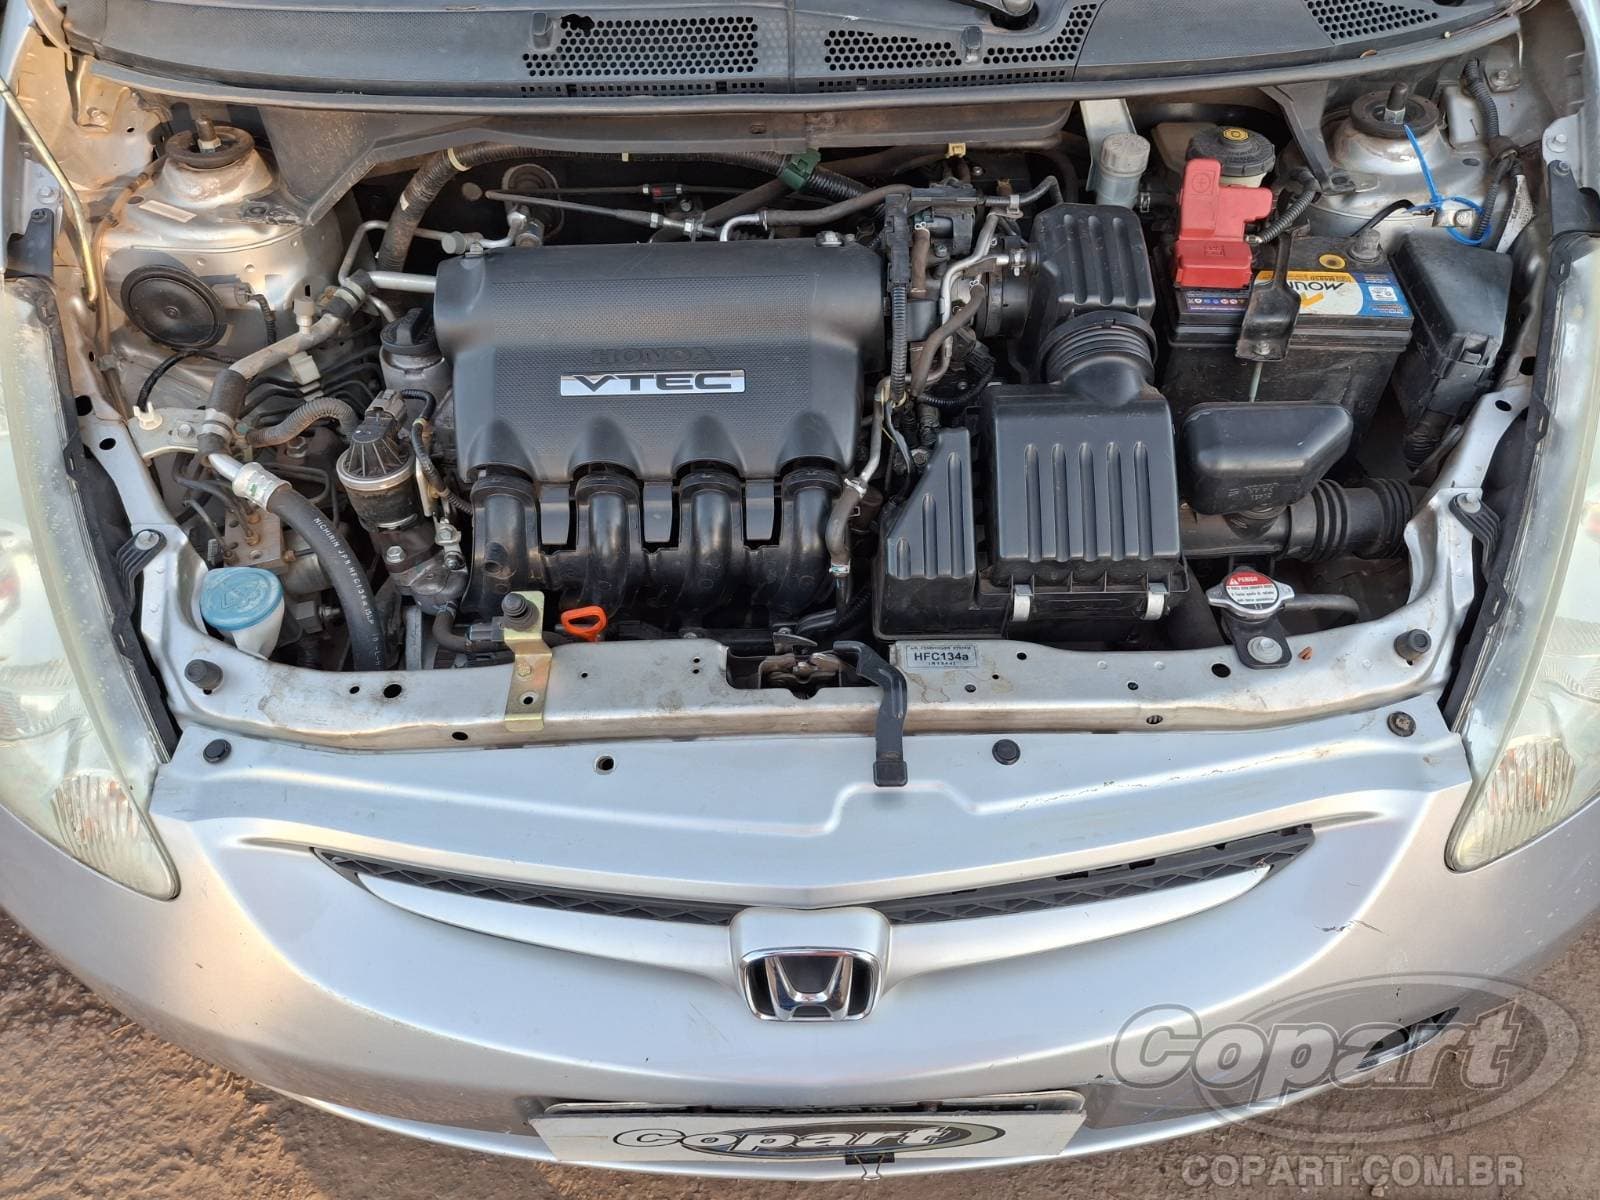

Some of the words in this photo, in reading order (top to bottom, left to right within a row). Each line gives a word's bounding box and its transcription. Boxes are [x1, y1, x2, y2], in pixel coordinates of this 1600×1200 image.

[592, 348, 716, 364] HONDA
[573, 373, 732, 392] VTEC
[313, 517, 341, 548] NICHIRIN
[914, 652, 969, 661] HFC134a
[613, 1125, 952, 1153] Copart
